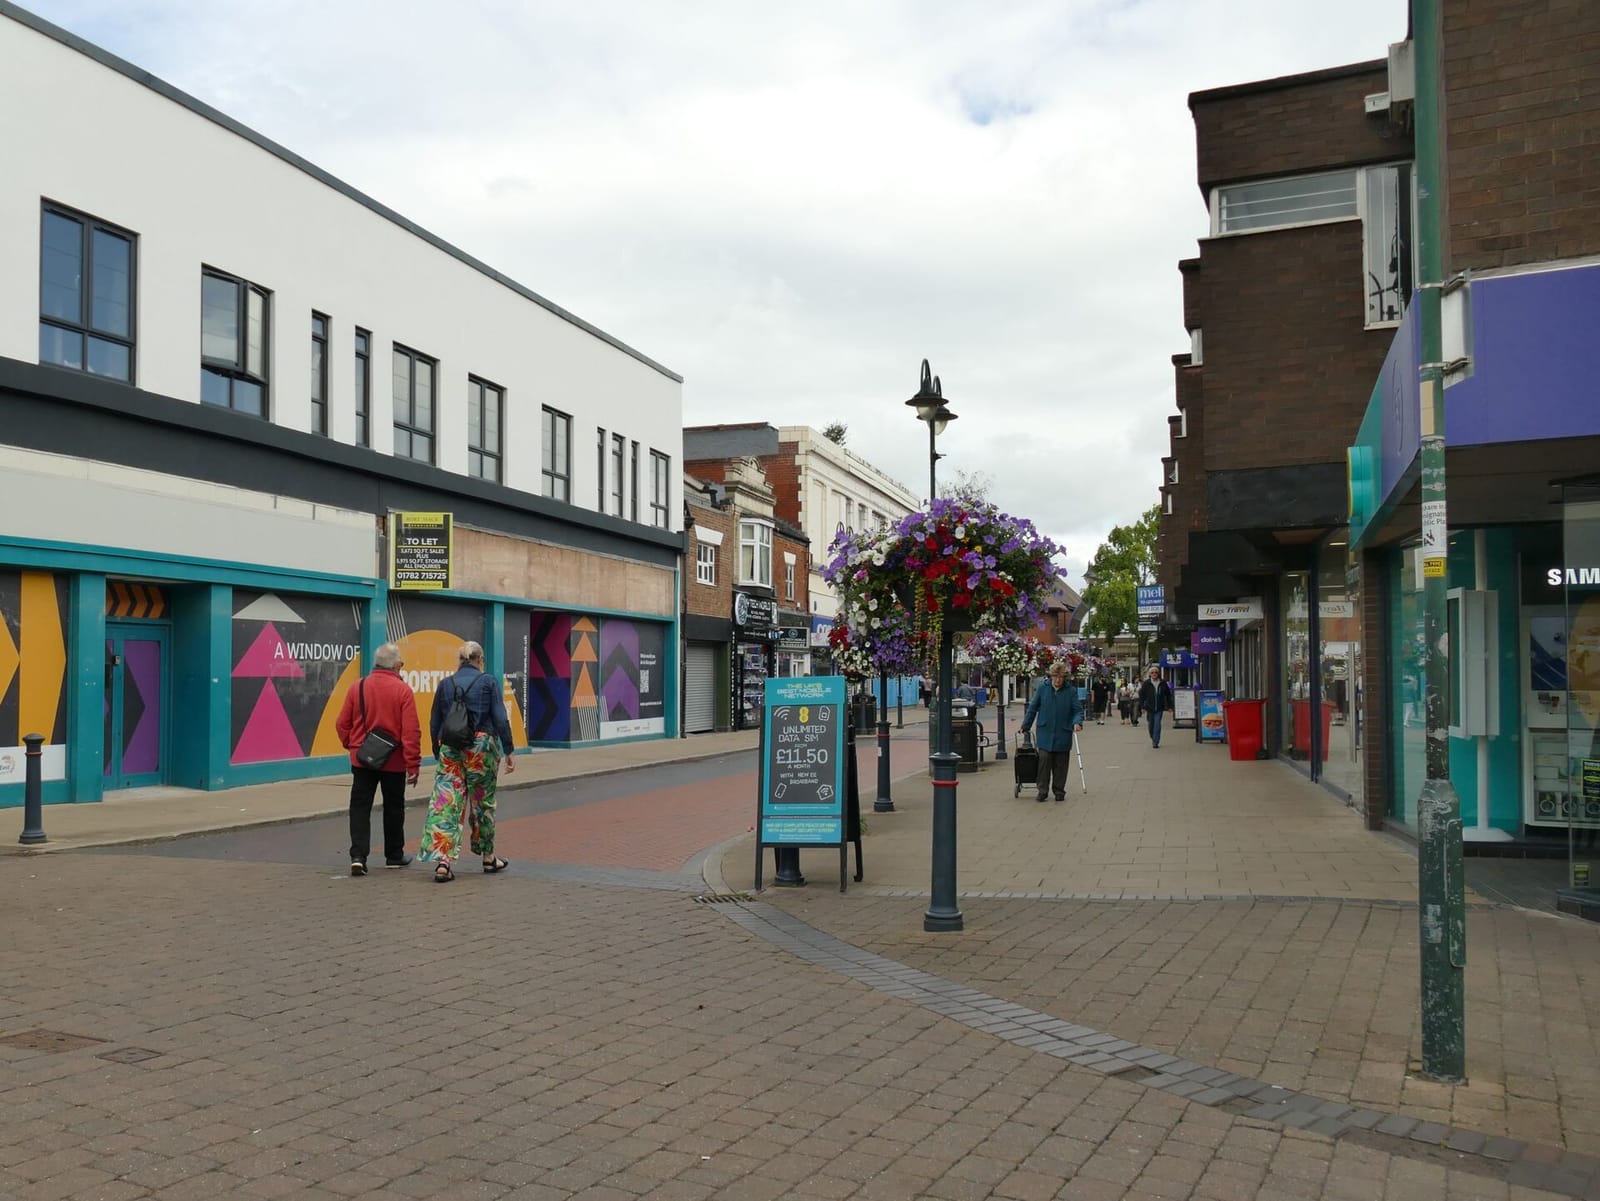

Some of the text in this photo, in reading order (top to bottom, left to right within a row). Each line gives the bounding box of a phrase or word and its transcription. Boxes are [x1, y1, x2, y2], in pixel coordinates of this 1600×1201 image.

[406, 537, 438, 546] TO LET
[397, 572, 447, 580] 01782 715725
[1206, 605, 1250, 616] Hays Travel
[273, 641, 361, 661] A WINDOW OF
[783, 725, 826, 734] UNLIMITED
[778, 734, 819, 742] DATA SIM
[776, 748, 828, 764] £11.50
